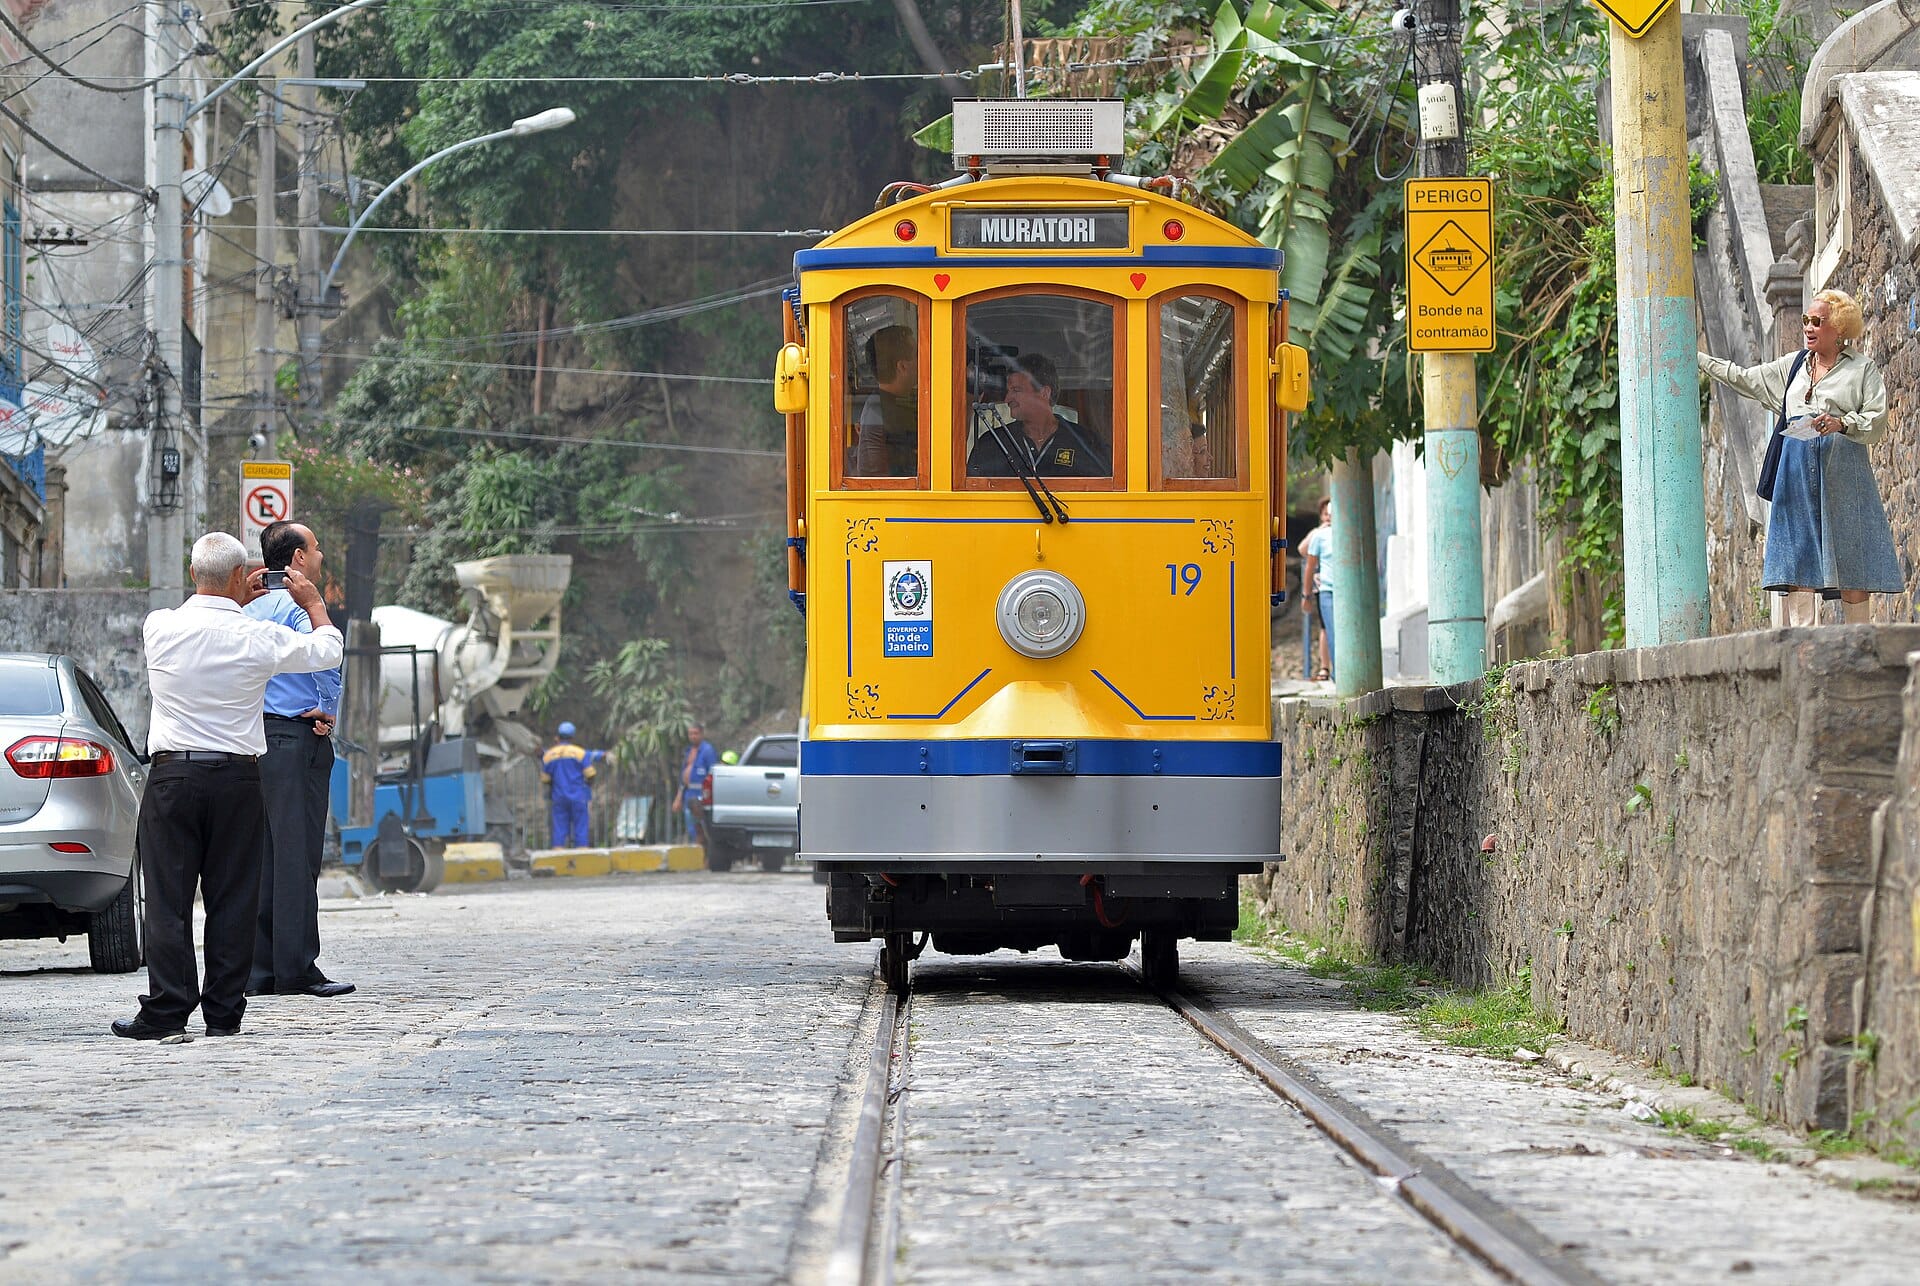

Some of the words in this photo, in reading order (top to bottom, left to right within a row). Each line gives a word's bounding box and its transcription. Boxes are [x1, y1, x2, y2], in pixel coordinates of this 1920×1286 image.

[1415, 189, 1482, 203] PERIGO
[981, 217, 1096, 243] MURATORI
[1418, 304, 1462, 316] Bonde
[1466, 306, 1483, 316] na
[1416, 325, 1488, 338] contramão
[245, 465, 288, 476] CUIDADO
[259, 494, 274, 518] E
[1165, 563, 1202, 596] 19
[887, 633, 905, 642] Rio
[906, 633, 921, 642] de
[887, 642, 929, 652] Janeiro
